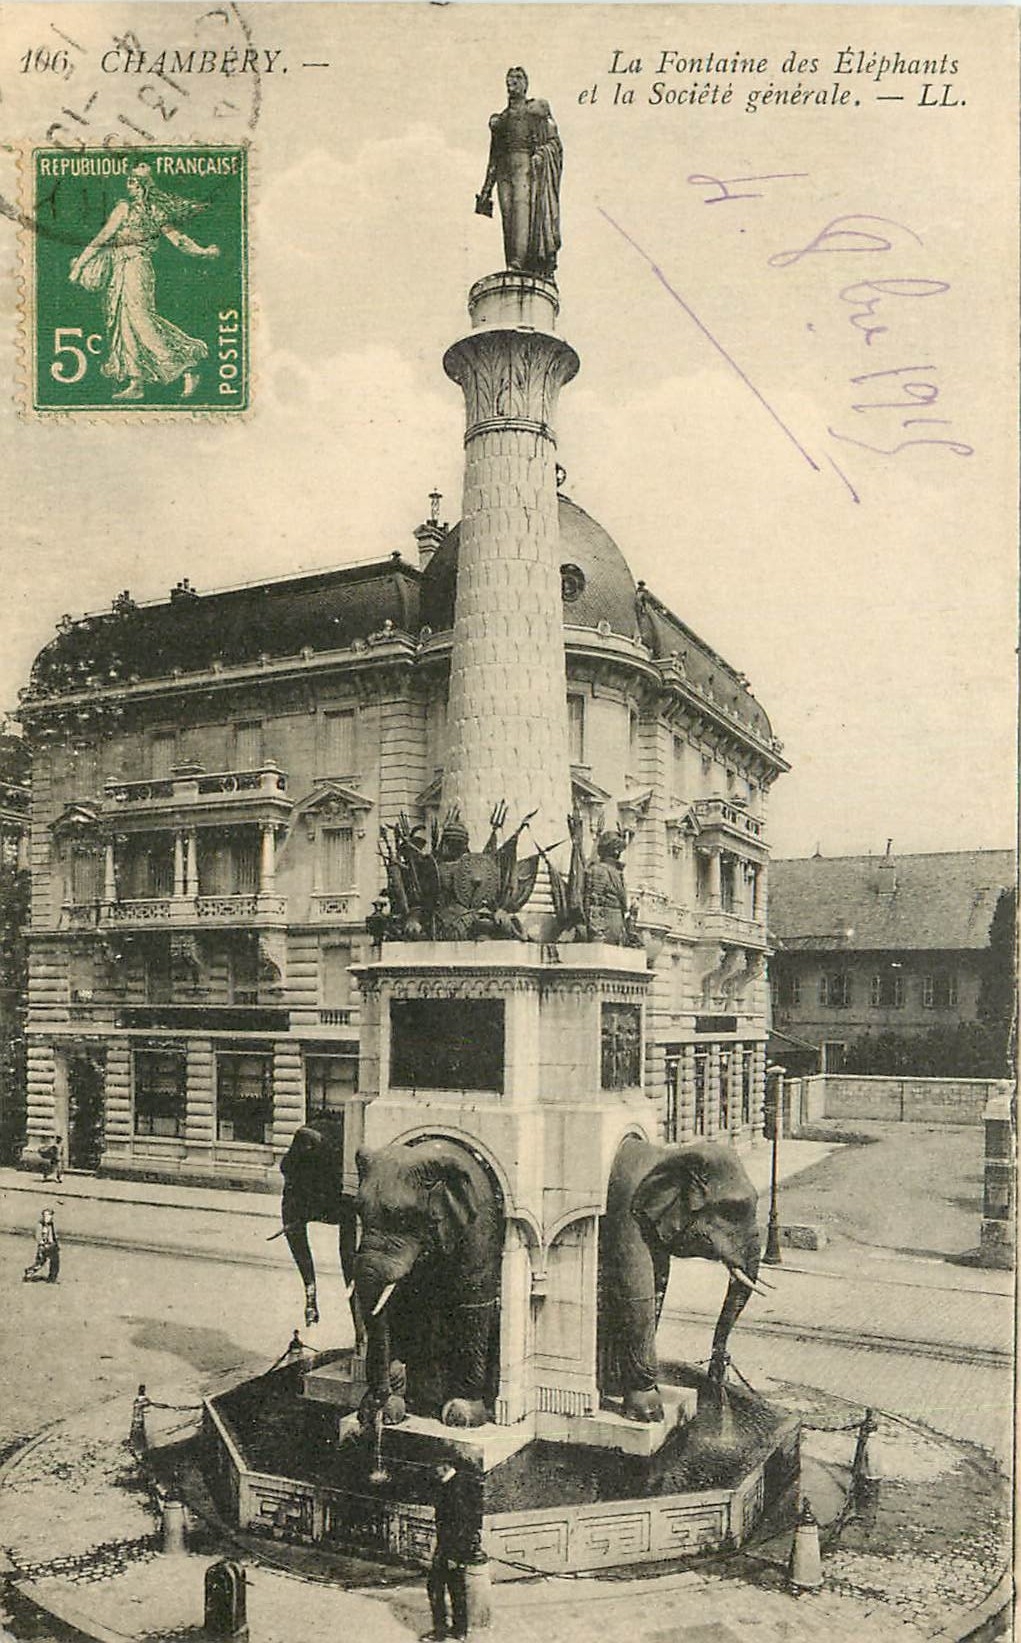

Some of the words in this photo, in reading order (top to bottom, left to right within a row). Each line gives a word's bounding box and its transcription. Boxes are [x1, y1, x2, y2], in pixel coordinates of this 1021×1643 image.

[40, 157, 129, 176] REPUBLIQUE
[155, 156, 239, 177] FRANÇAISE
[218, 309, 239, 395] POSTES
